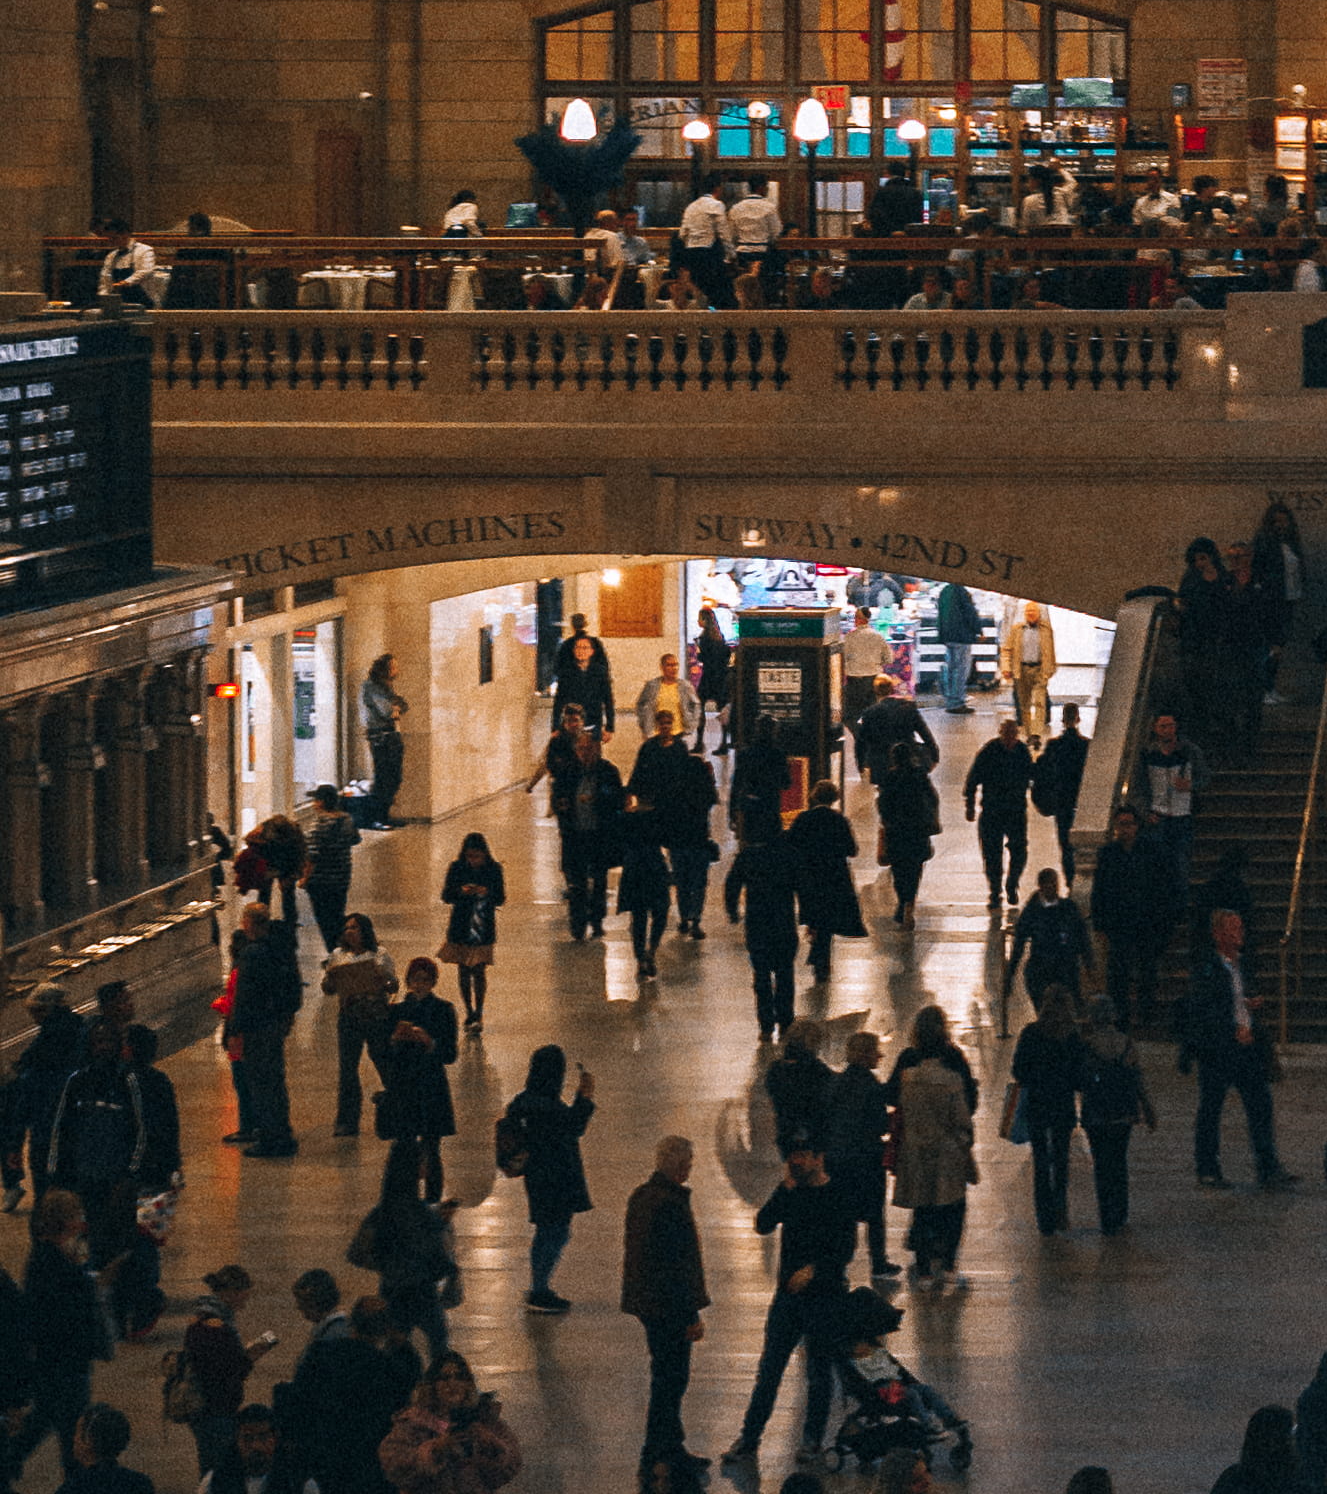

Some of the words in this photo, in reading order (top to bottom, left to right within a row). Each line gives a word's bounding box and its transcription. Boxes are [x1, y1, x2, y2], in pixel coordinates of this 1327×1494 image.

[213, 532, 354, 578] TICKET
[366, 511, 566, 554] MACHINES
[872, 532, 968, 570] 42ND
[977, 549, 1025, 581] ST
